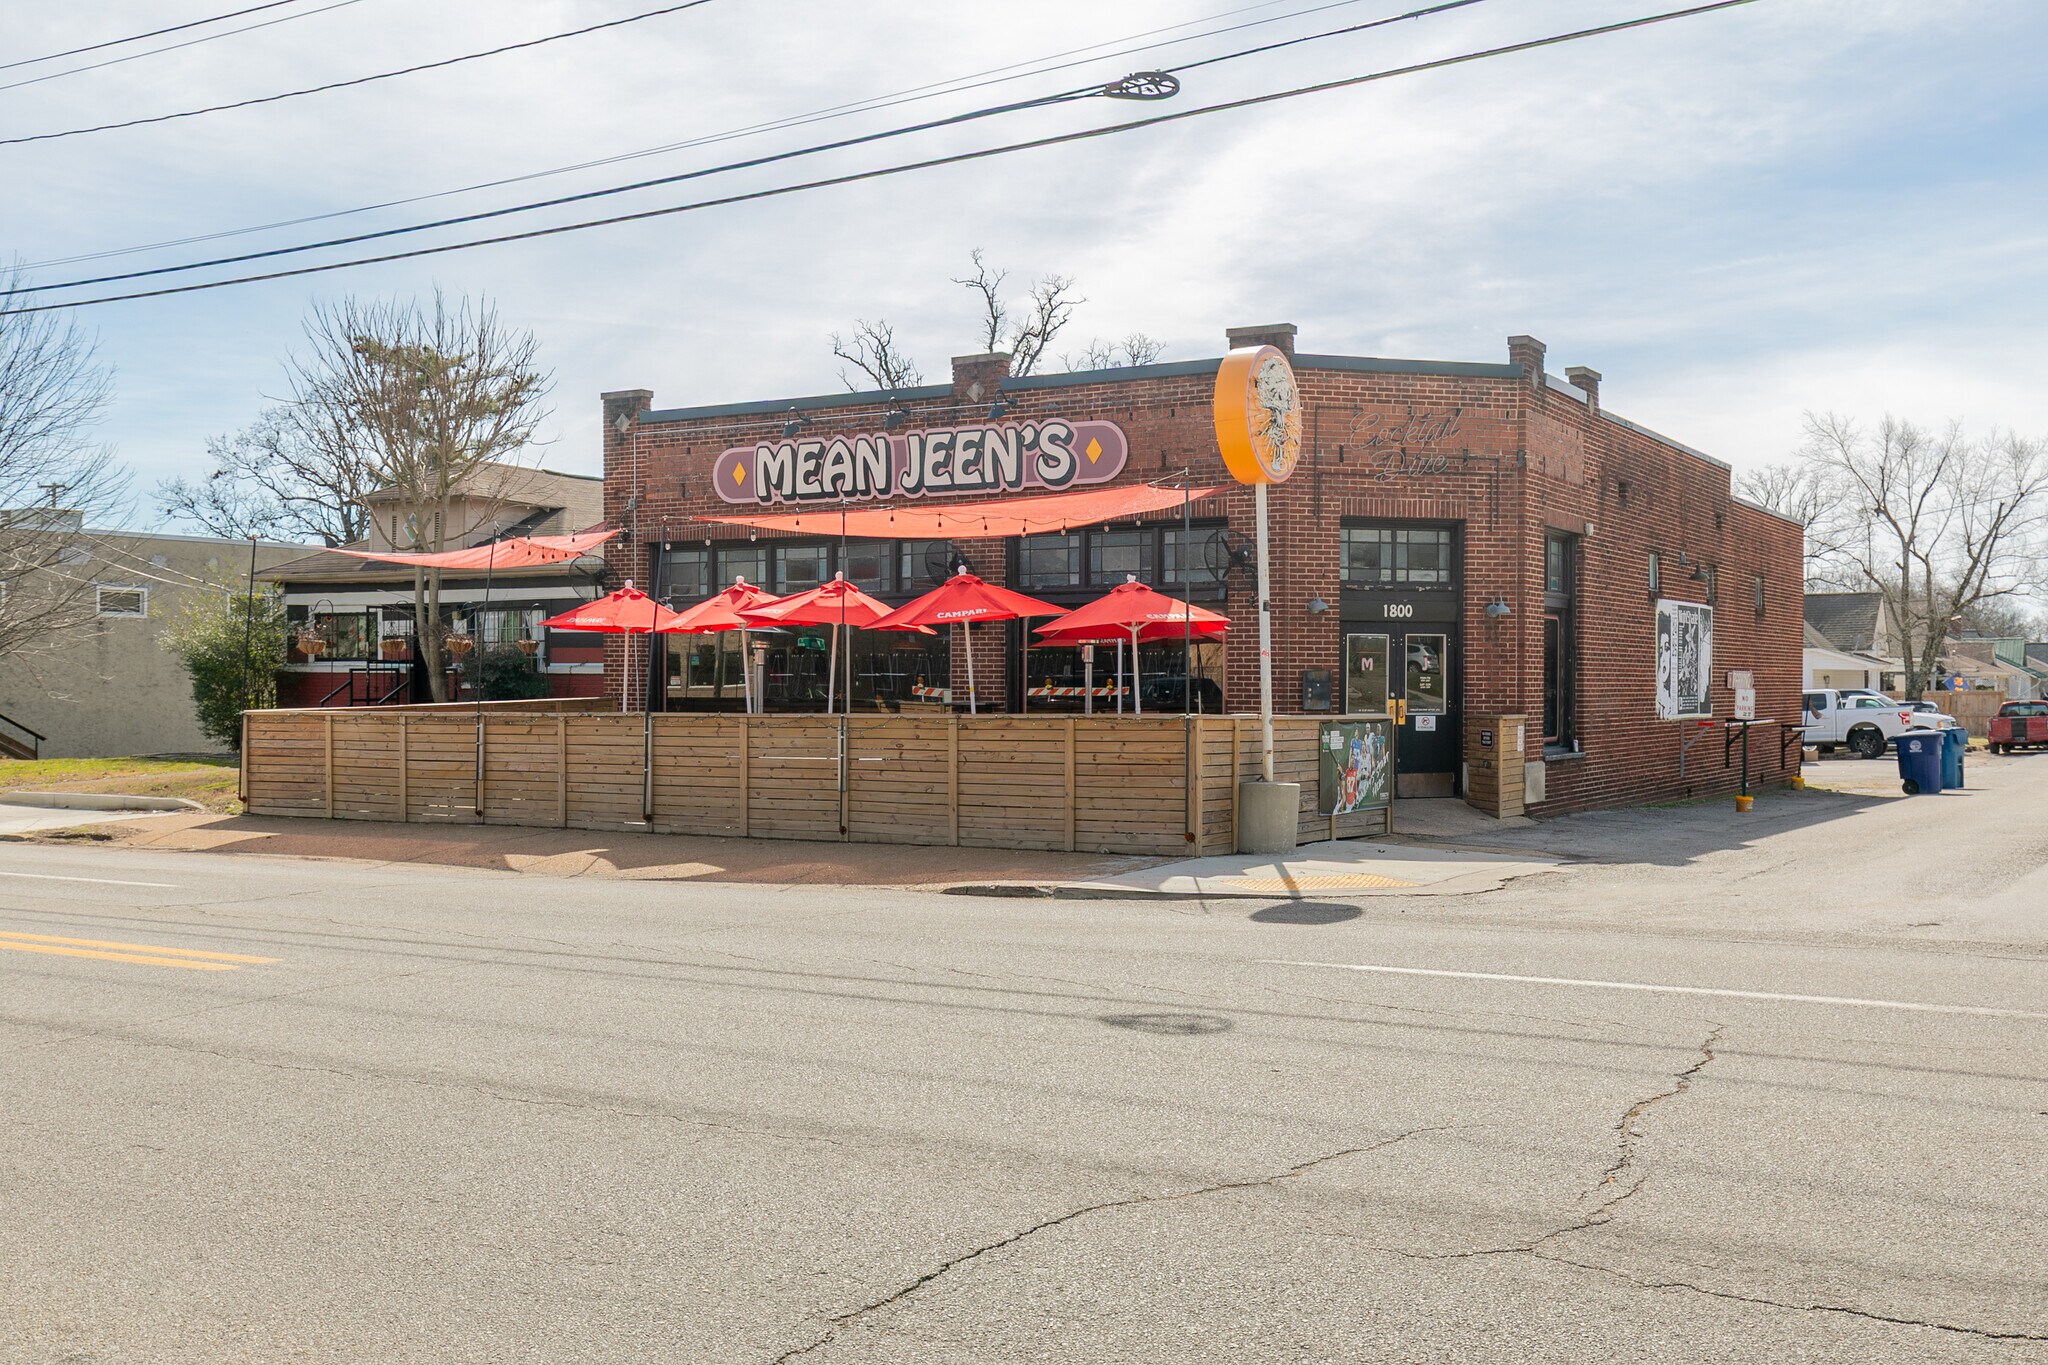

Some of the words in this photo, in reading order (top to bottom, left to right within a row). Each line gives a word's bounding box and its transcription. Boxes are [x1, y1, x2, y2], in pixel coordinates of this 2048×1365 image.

[1350, 409, 1463, 450] Cocktail
[755, 437, 893, 502] MEAN
[900, 423, 1076, 489] JEEN'S
[937, 608, 987, 619] CAMPARI
[1383, 604, 1413, 618] 1800
[1361, 657, 1374, 671] M
